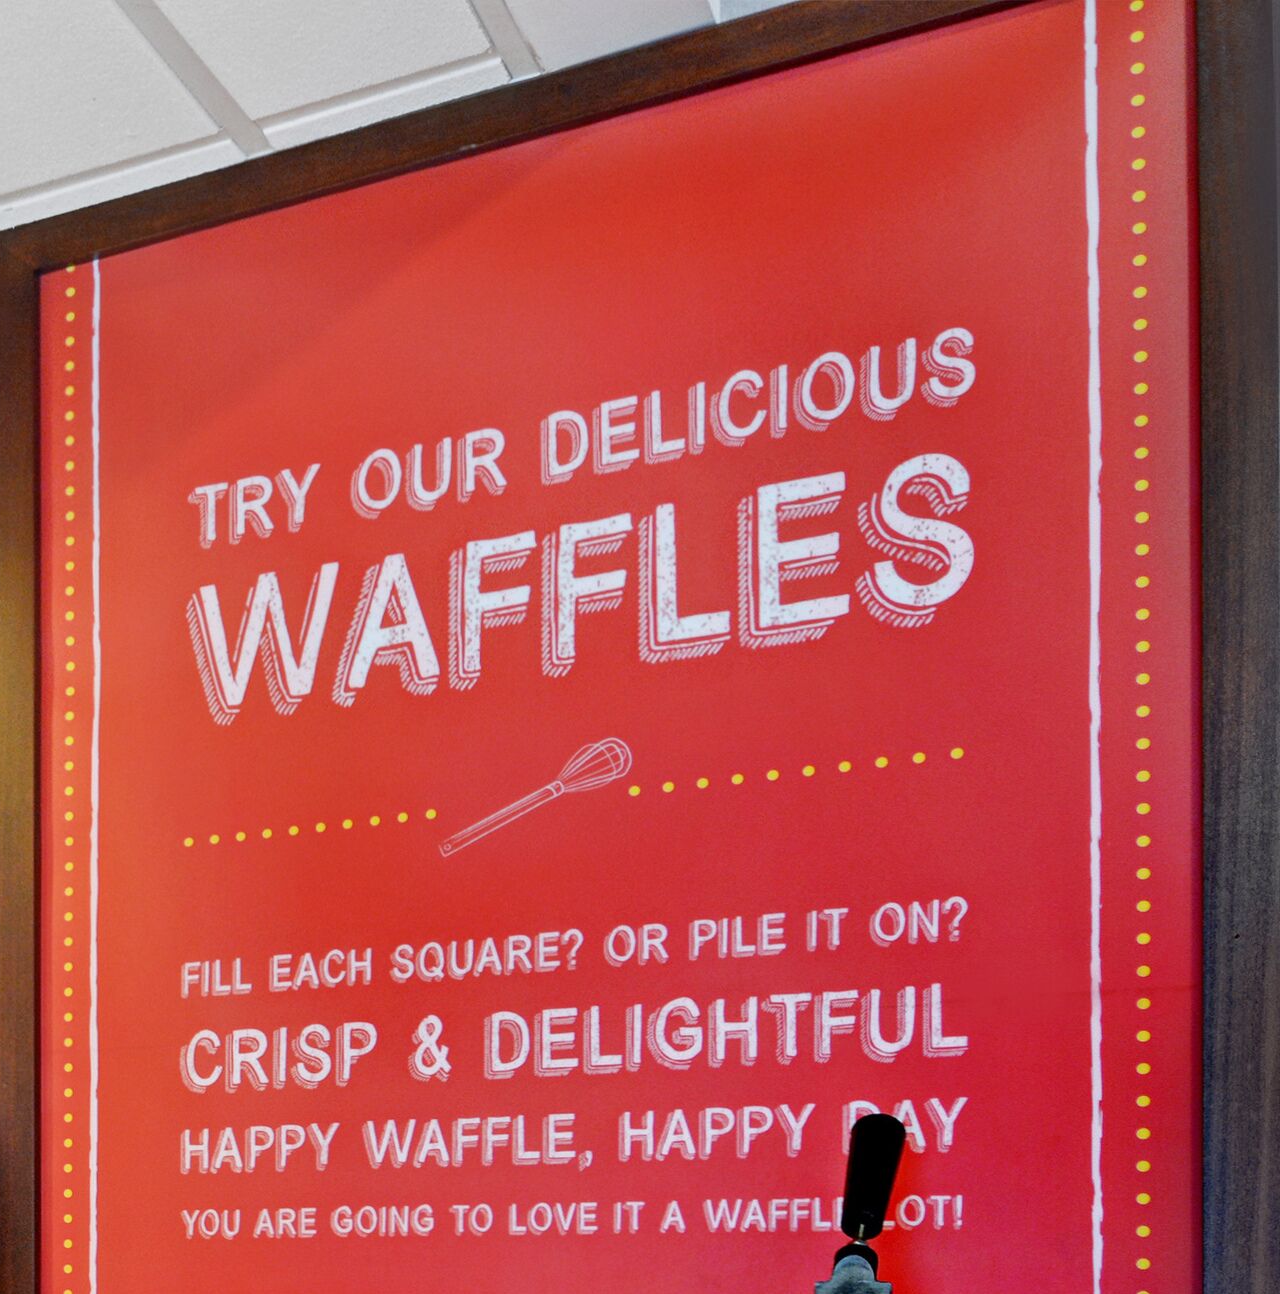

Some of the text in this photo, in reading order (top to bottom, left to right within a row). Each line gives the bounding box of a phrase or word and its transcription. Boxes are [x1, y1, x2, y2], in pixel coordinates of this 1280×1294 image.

[187, 326, 977, 550] TRY OUR DELICIOUS
[185, 448, 975, 726] WAFFLES
[180, 895, 969, 999] FILL EACH SQUARE? OR PILE IT ON?
[179, 982, 969, 1094] CRISP & DELIGHTFUL
[180, 1122, 340, 1175] HAPPY
[361, 1112, 593, 1172] WAFFLE,
[618, 1102, 816, 1163] HAPPY
[181, 1208, 241, 1241] YOU
[252, 1207, 317, 1239] ARE
[330, 1203, 435, 1238] GOING
[448, 1202, 494, 1236] TO
[508, 1201, 599, 1236] LOVE
[612, 1200, 646, 1234] IT
[659, 1199, 686, 1234] A
[882, 1193, 964, 1231] OT!
